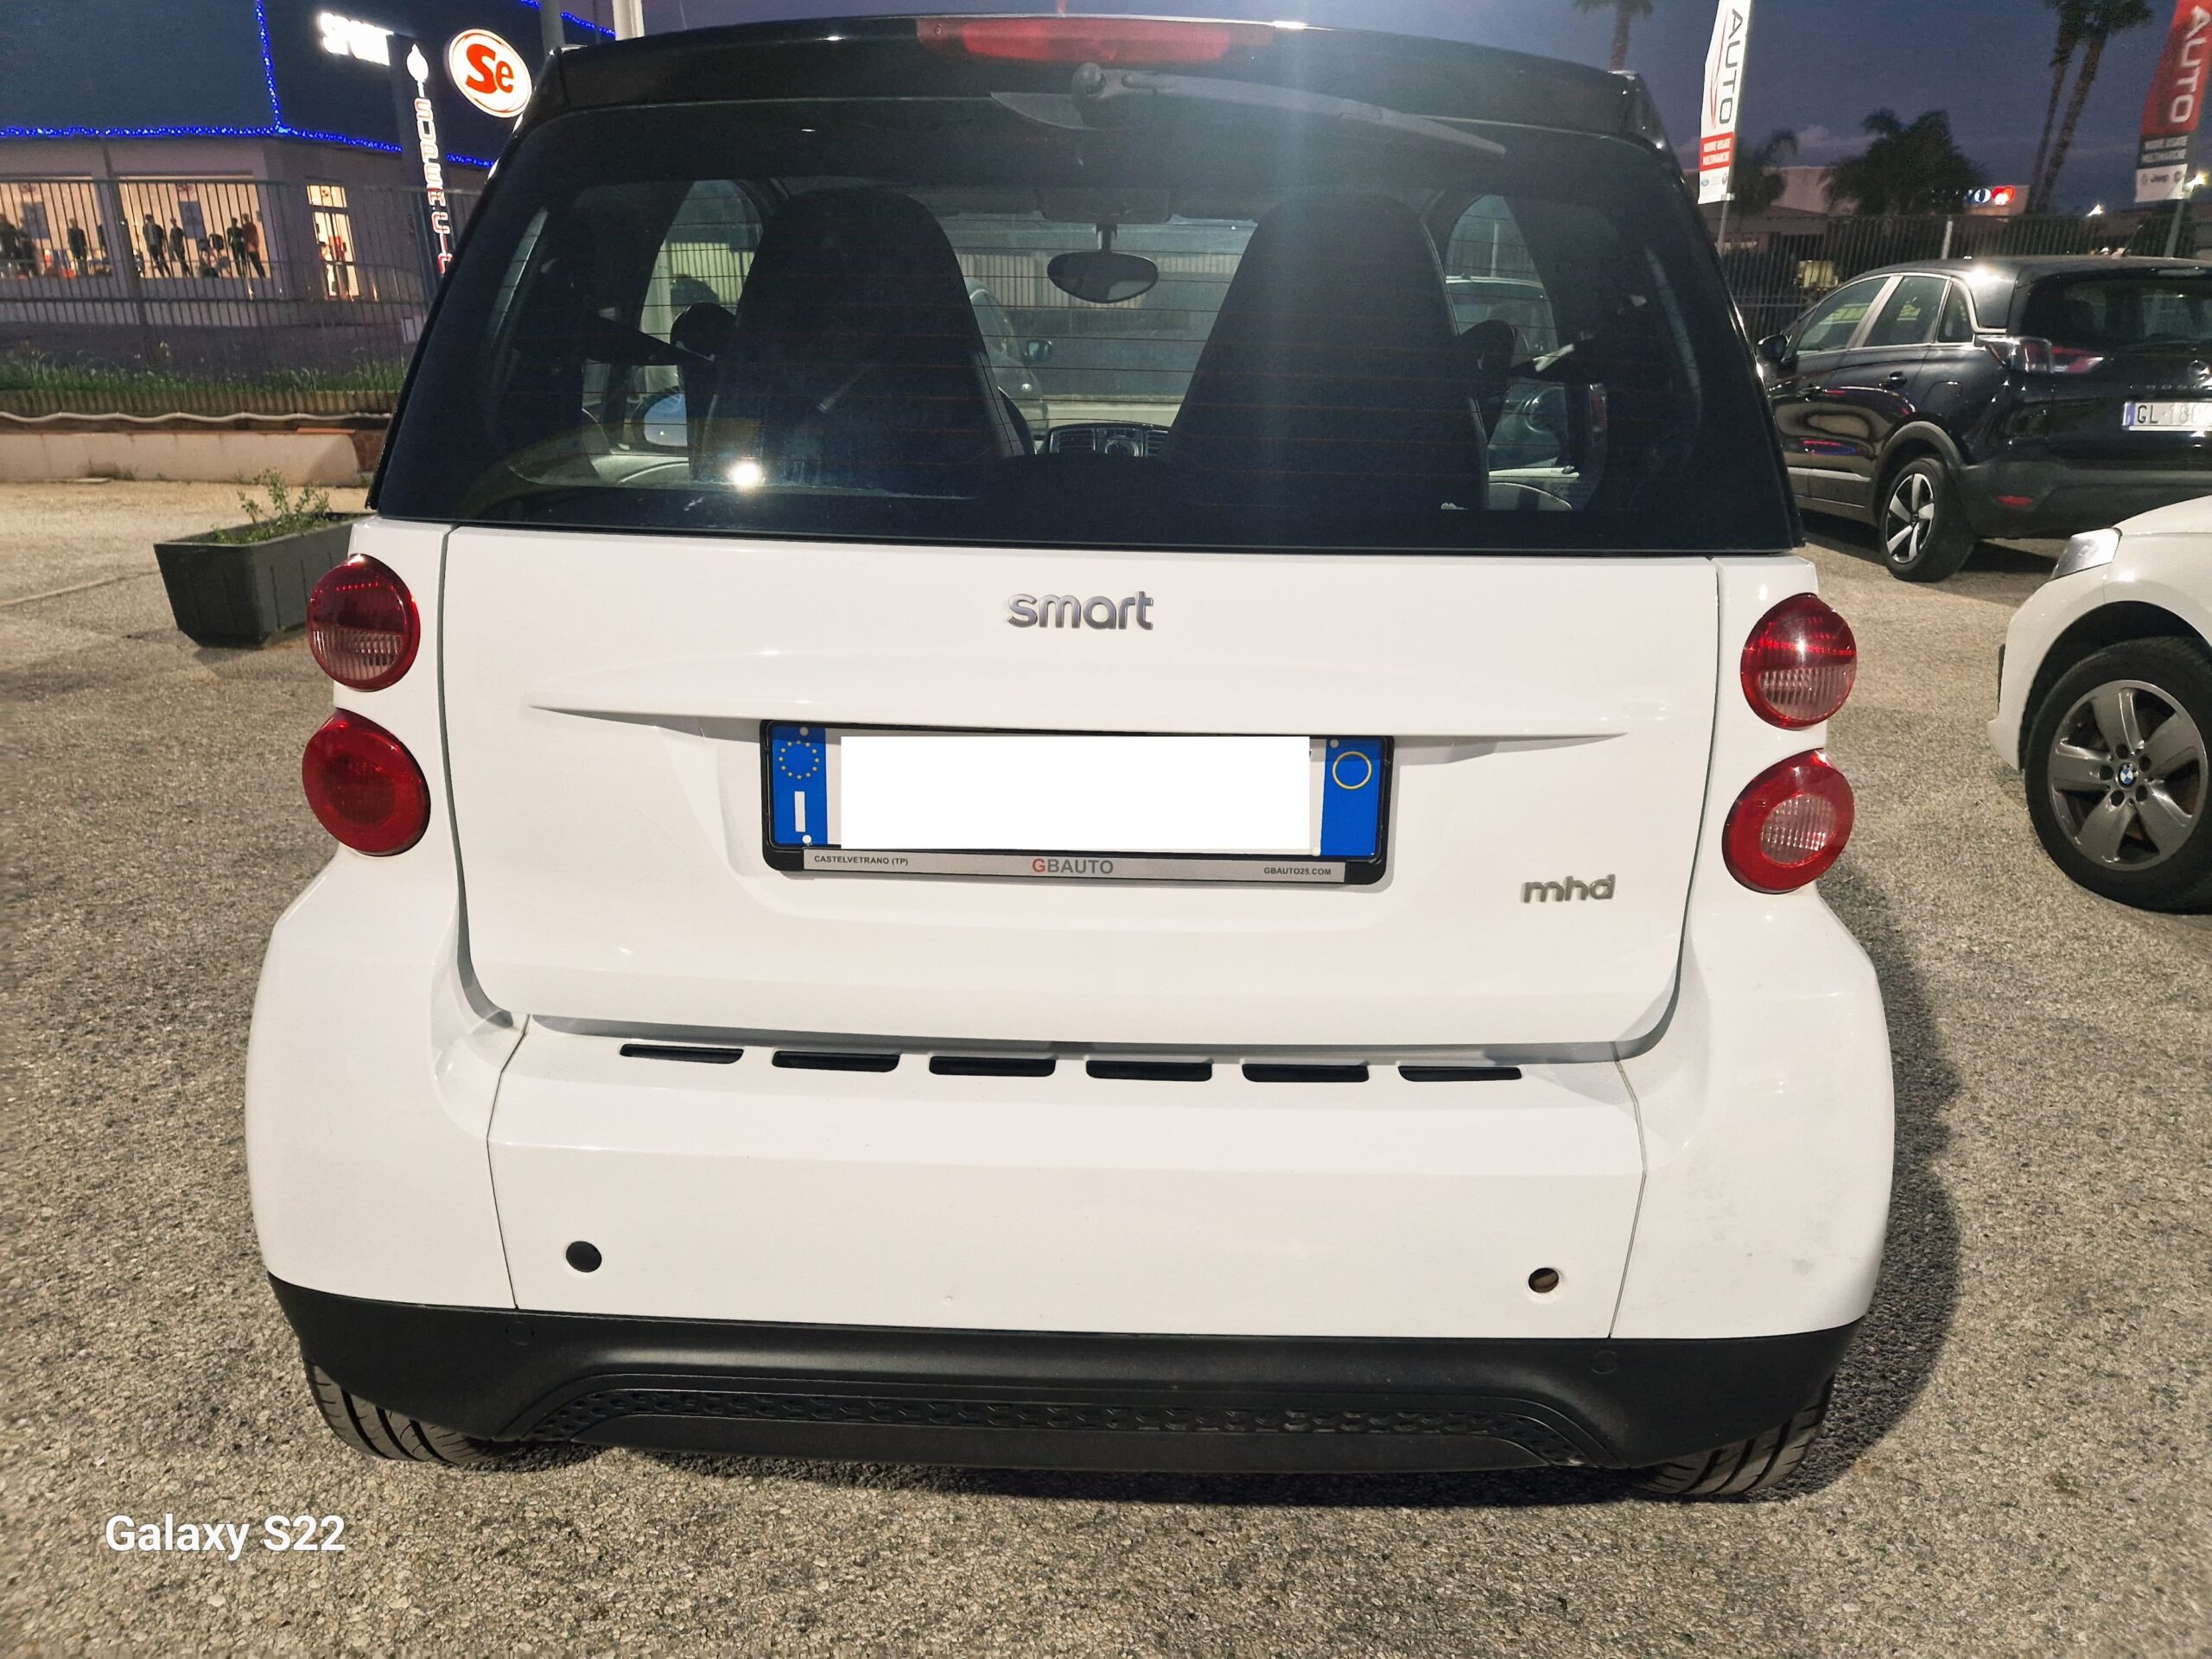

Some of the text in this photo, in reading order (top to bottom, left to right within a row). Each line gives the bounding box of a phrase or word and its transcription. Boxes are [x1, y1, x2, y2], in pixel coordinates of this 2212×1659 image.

[465, 43, 514, 94] Se
[1719, 8, 1744, 124] AUTO
[2170, 4, 2212, 123] AUTO
[415, 98, 446, 207] SUPER
[2137, 404, 2158, 424] GL
[1007, 591, 1154, 631] smart
[814, 855, 908, 866] CASTELVETRANO (TP)
[1032, 858, 1114, 874] GBAUTO
[1263, 867, 1332, 876] GBAUTO25.COM
[1521, 874, 1616, 903] mhd
